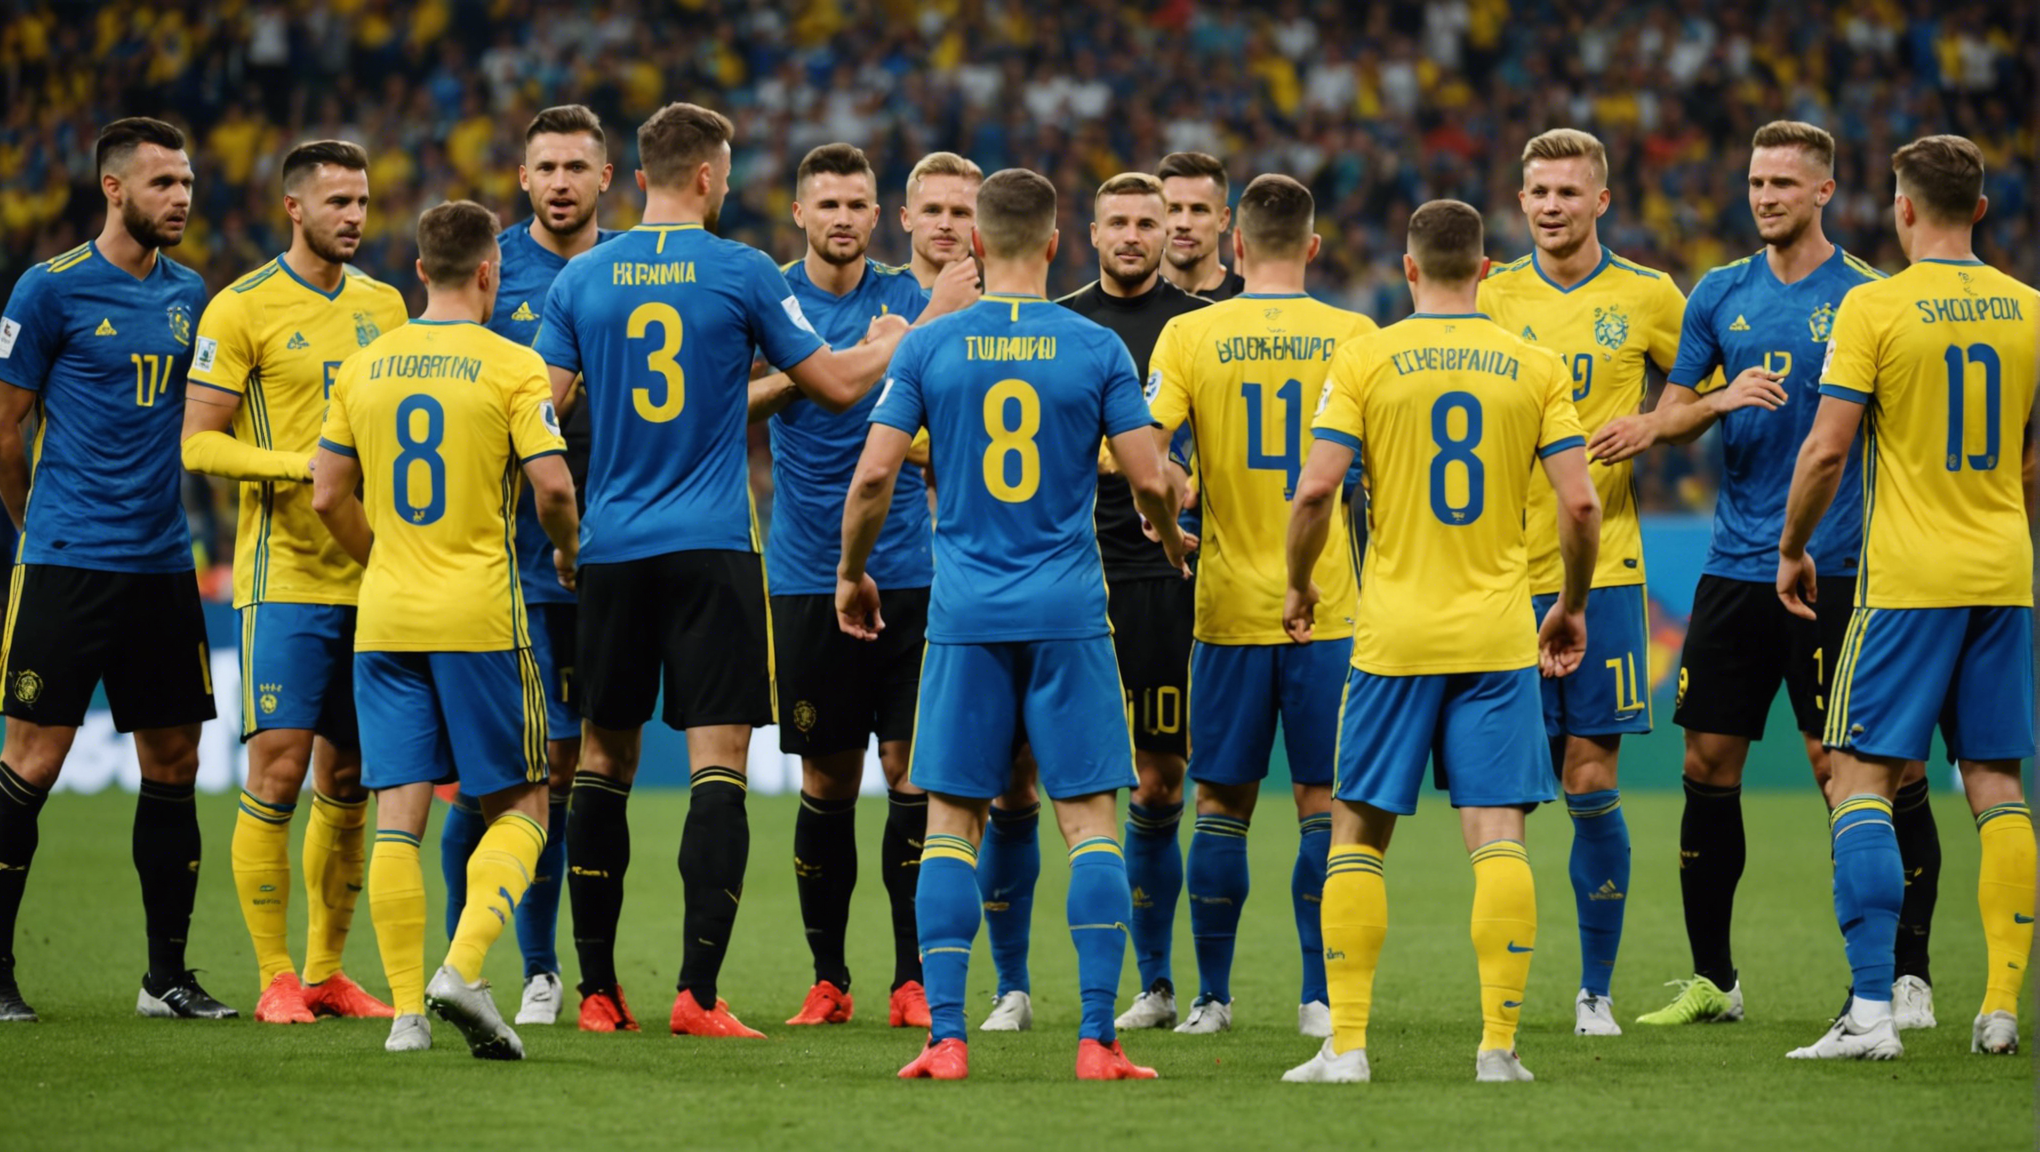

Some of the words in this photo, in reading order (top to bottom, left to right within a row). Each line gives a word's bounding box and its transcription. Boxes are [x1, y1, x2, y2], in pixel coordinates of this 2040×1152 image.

[627, 302, 685, 423] 3
[393, 393, 445, 526] 8
[983, 378, 1040, 503] 8
[1430, 391, 1484, 525] 8
